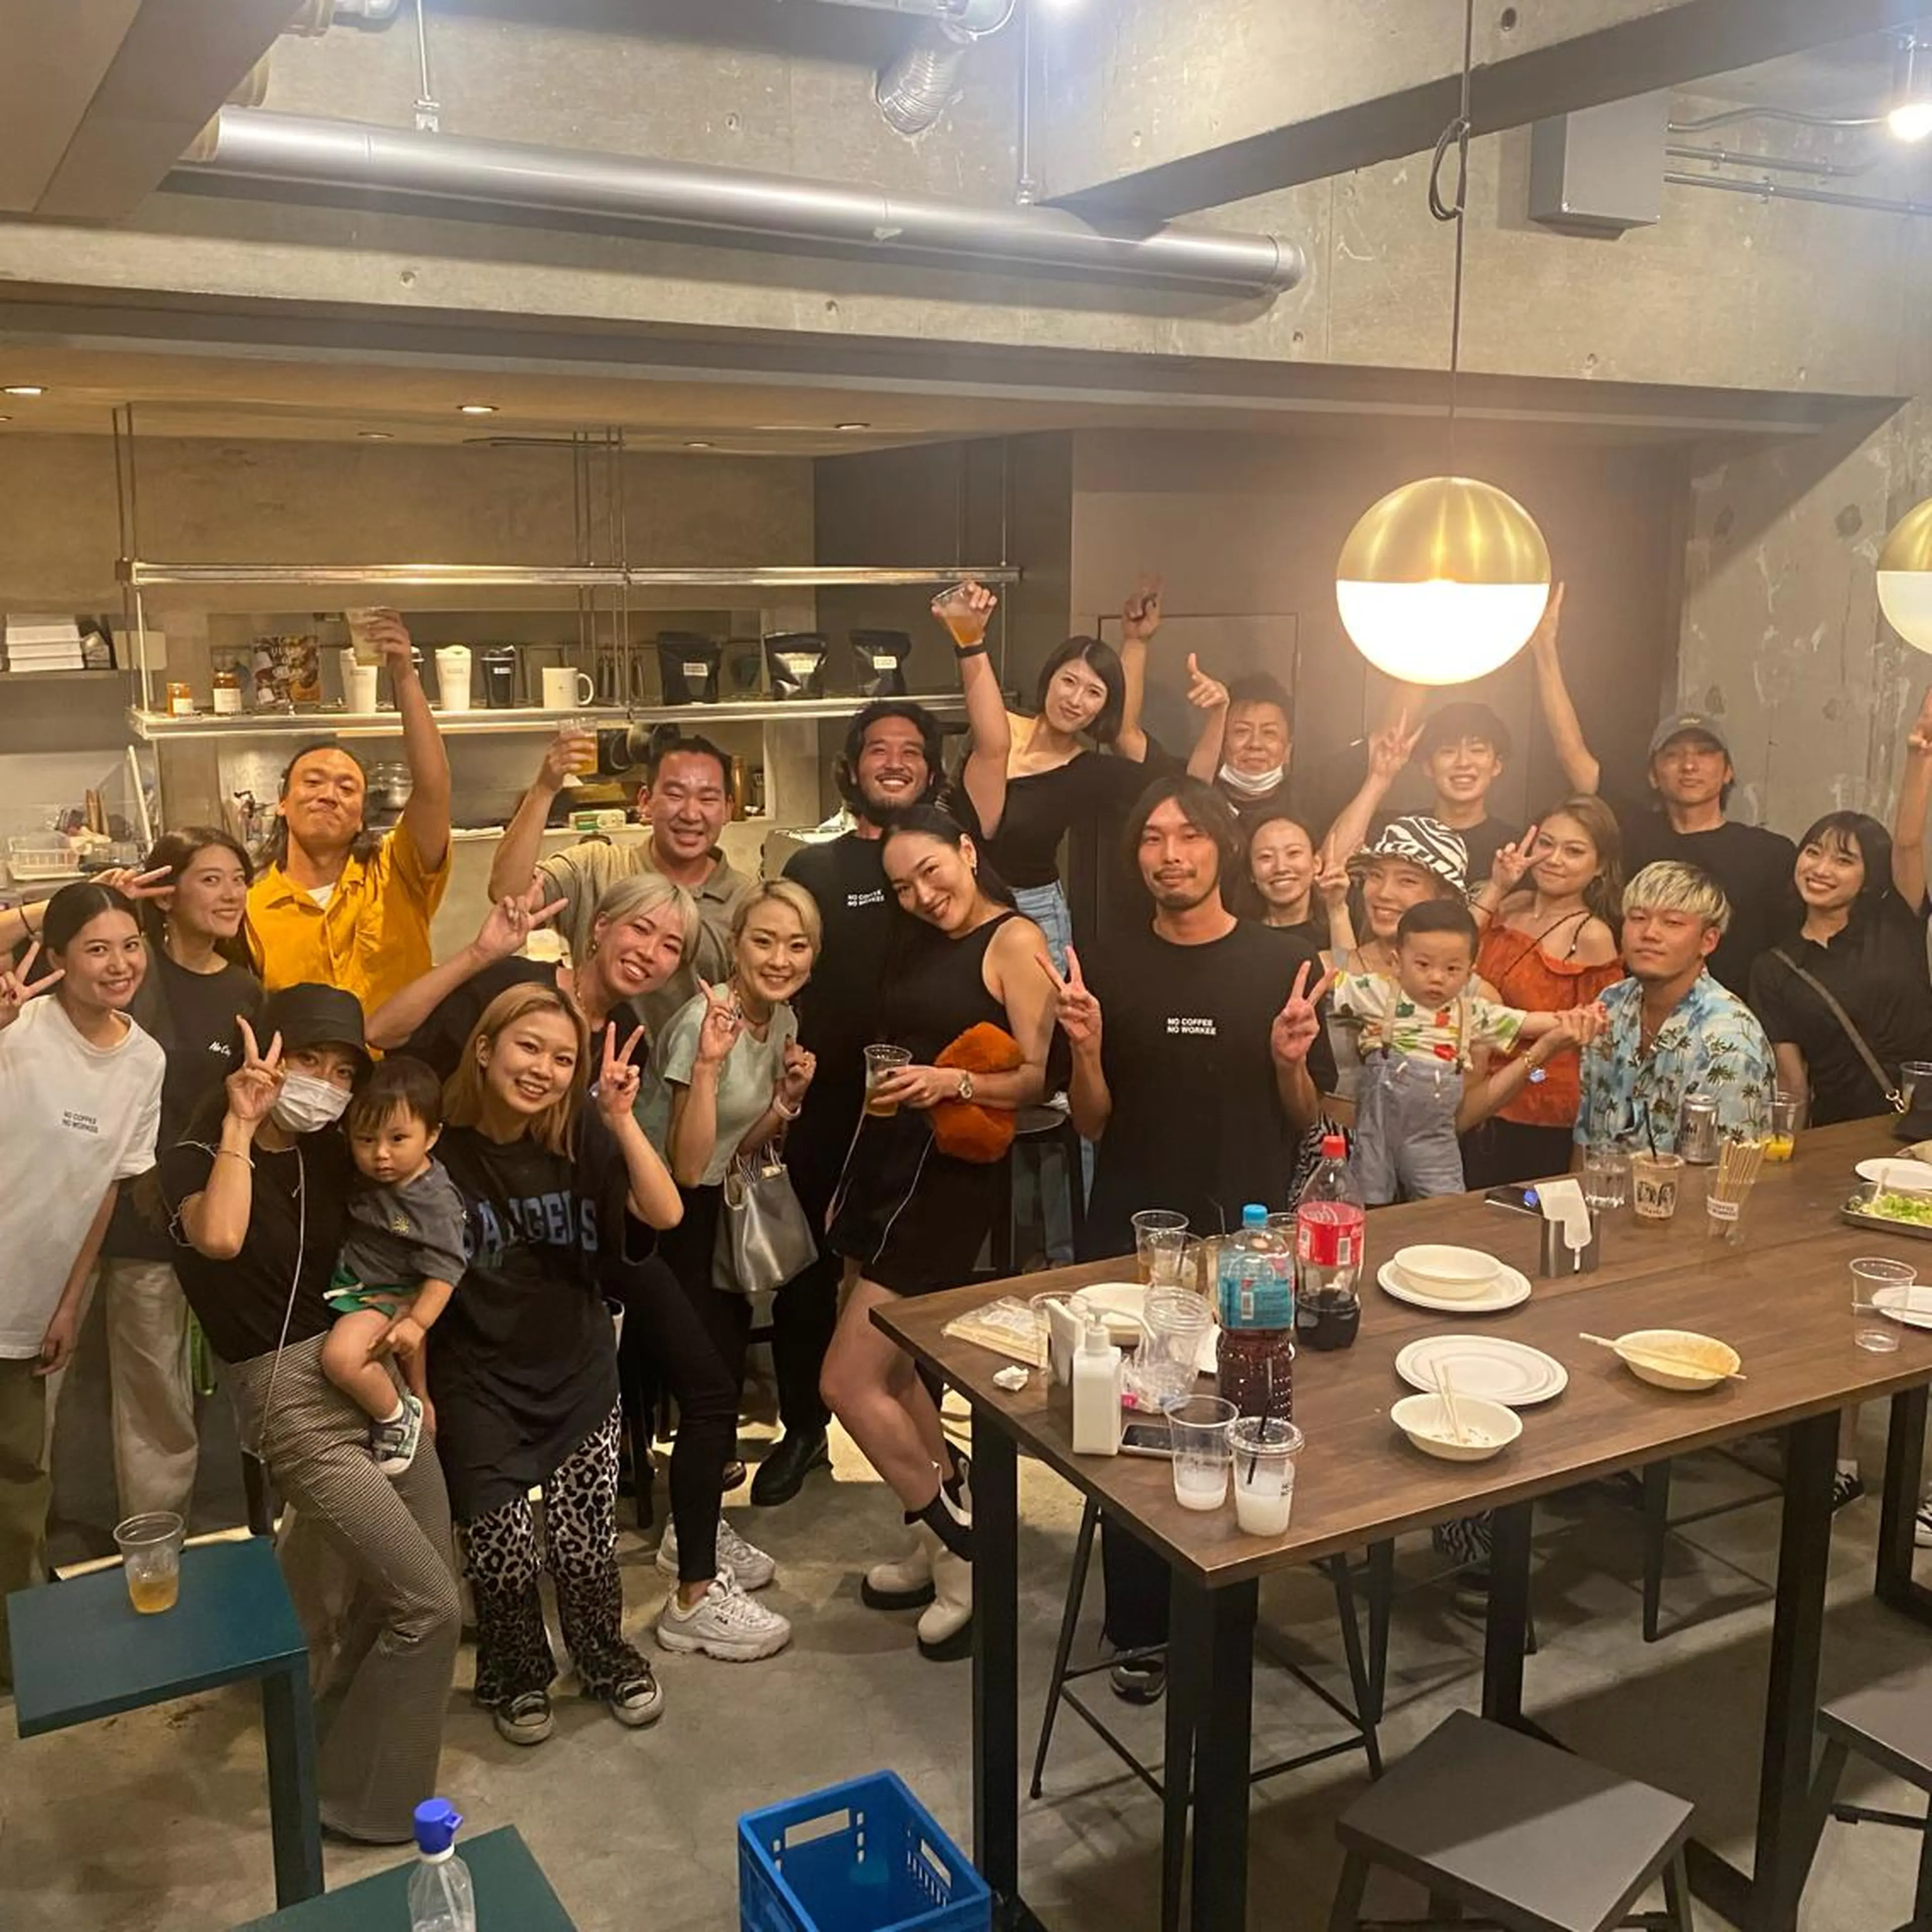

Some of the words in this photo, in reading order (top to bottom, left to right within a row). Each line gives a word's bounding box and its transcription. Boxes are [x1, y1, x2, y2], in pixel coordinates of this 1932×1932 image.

[1167, 1017, 1180, 1026] NO
[1181, 1017, 1213, 1026] COFFEE
[1181, 1026, 1217, 1035] WORKEE
